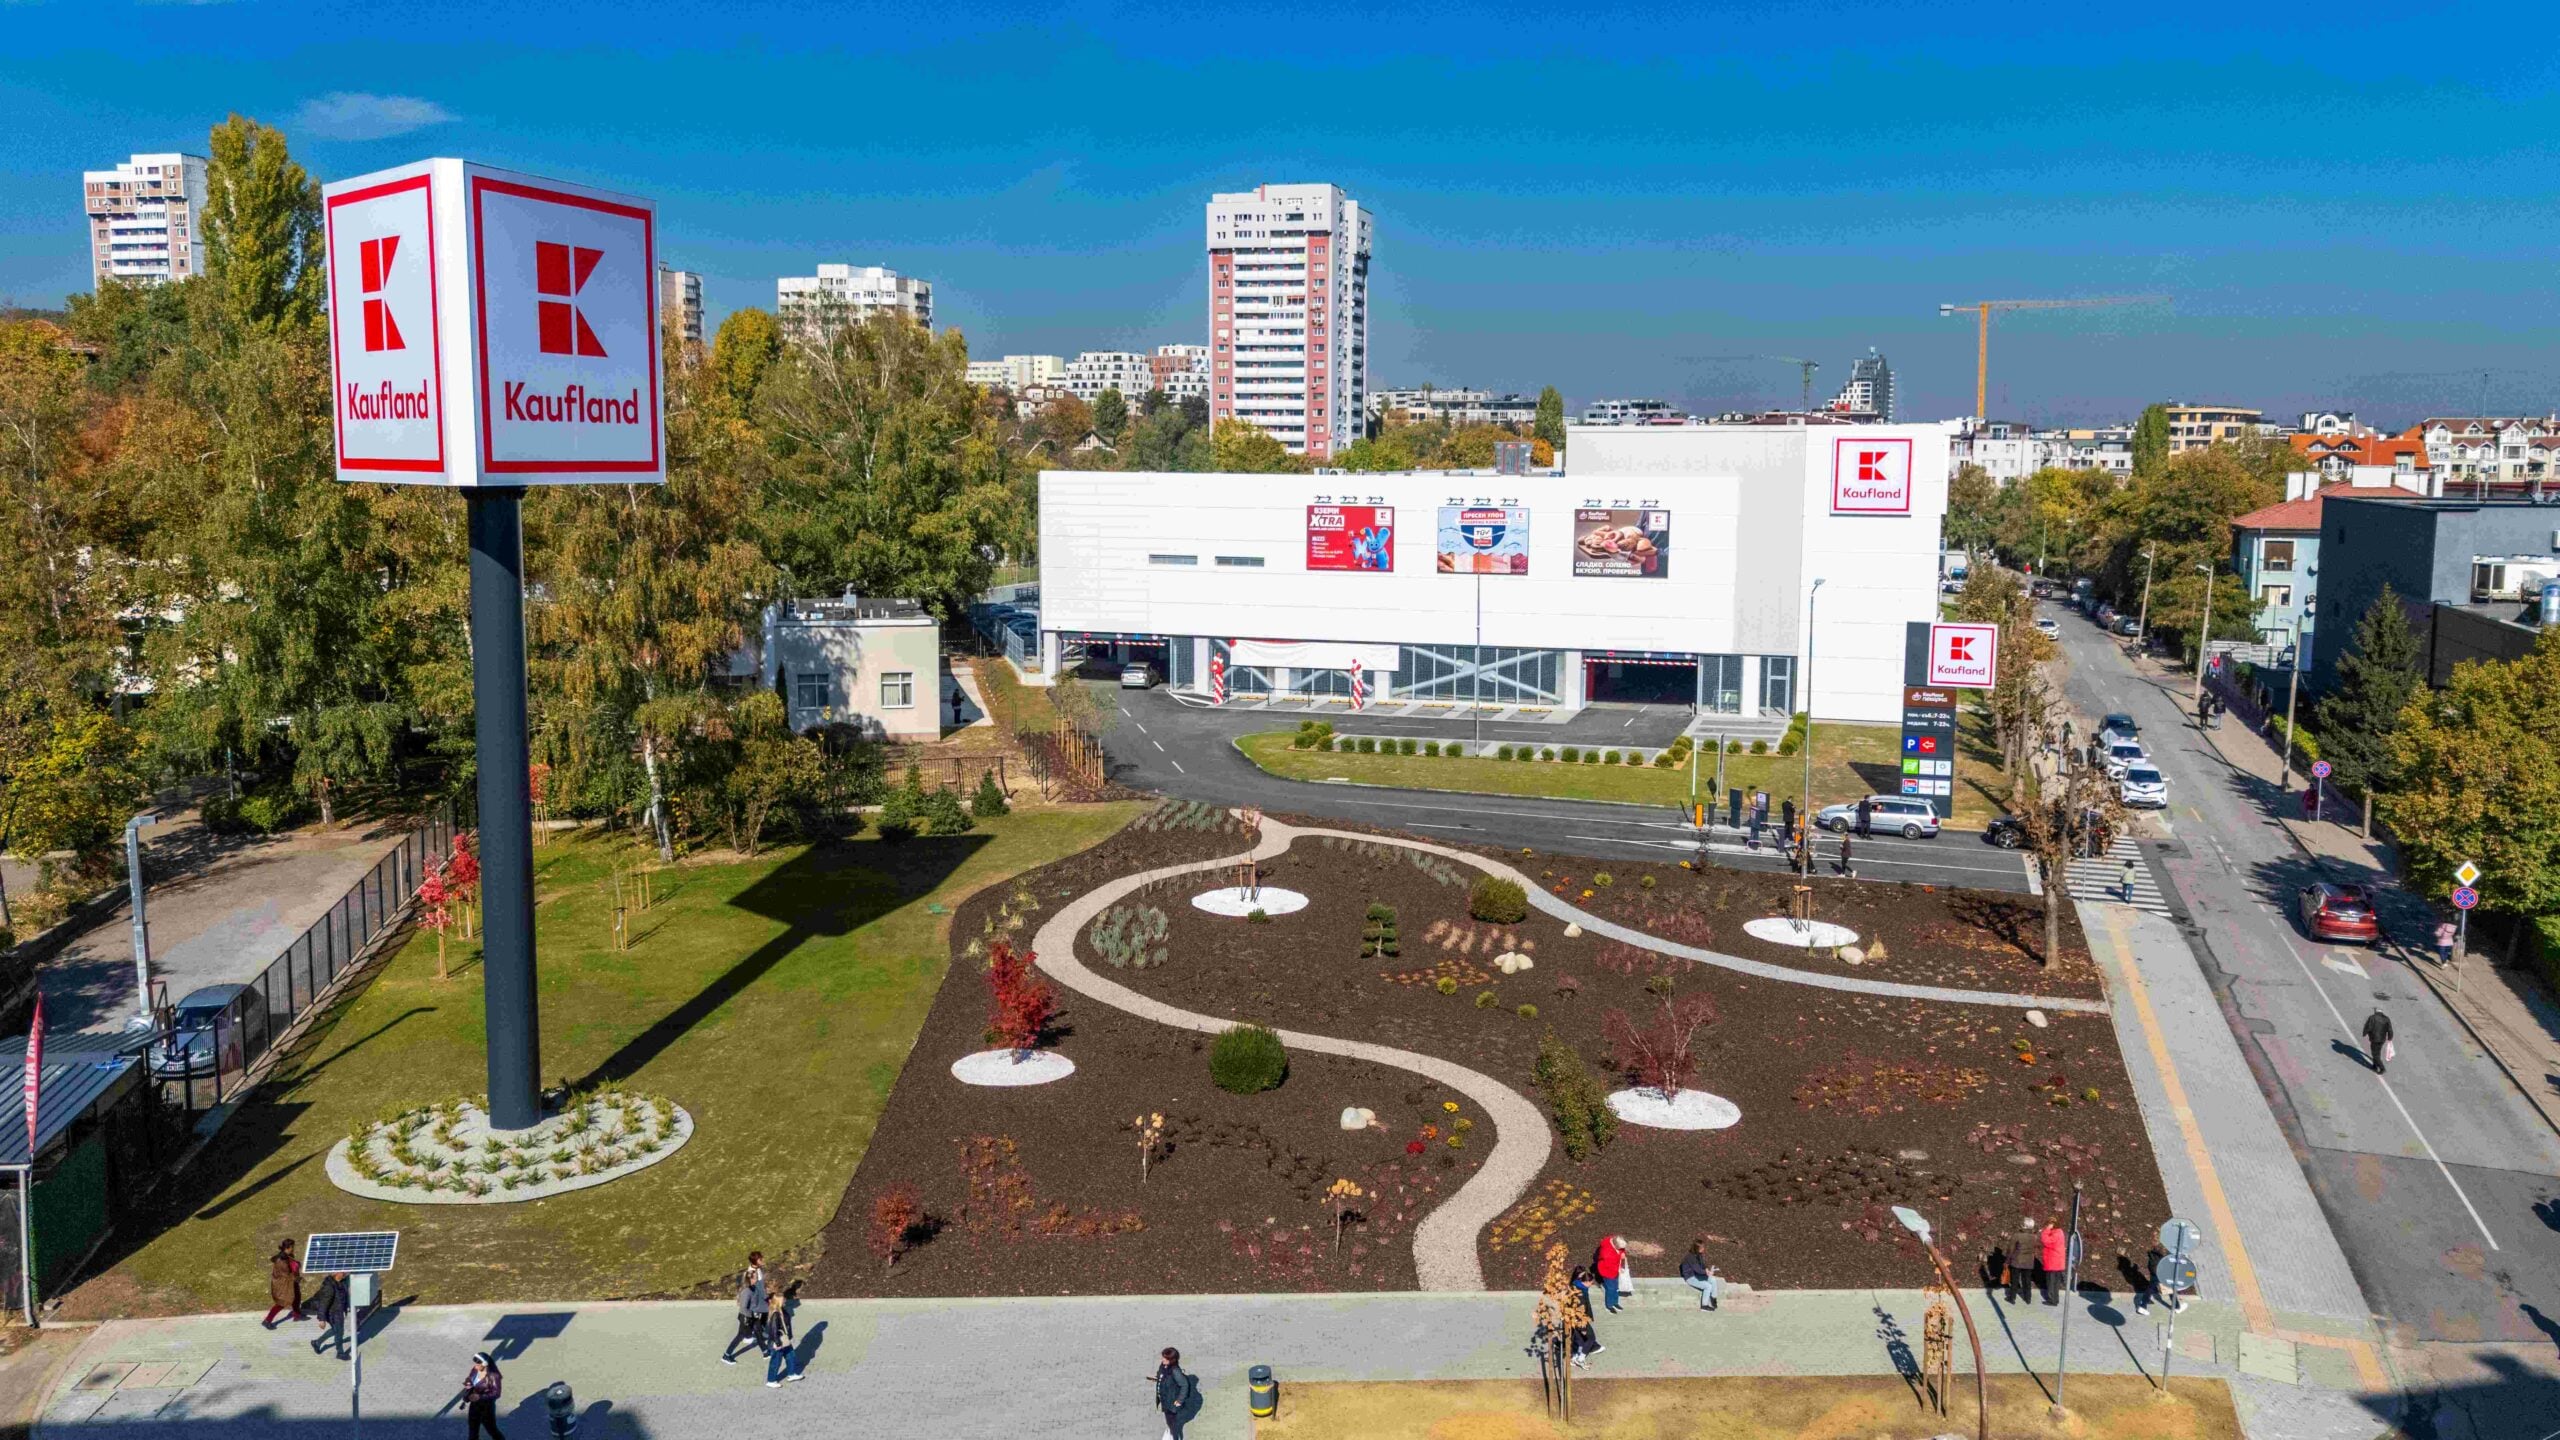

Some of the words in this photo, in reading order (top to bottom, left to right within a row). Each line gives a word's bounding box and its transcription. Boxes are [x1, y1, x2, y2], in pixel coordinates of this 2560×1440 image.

[348, 379, 429, 420] Kaufland
[504, 381, 639, 424] Kaufland
[1843, 488, 1901, 498] Kaufland
[1310, 515, 1344, 526] XTRA
[1937, 664, 1985, 676] Kaufland
[1907, 739, 1916, 749] P
